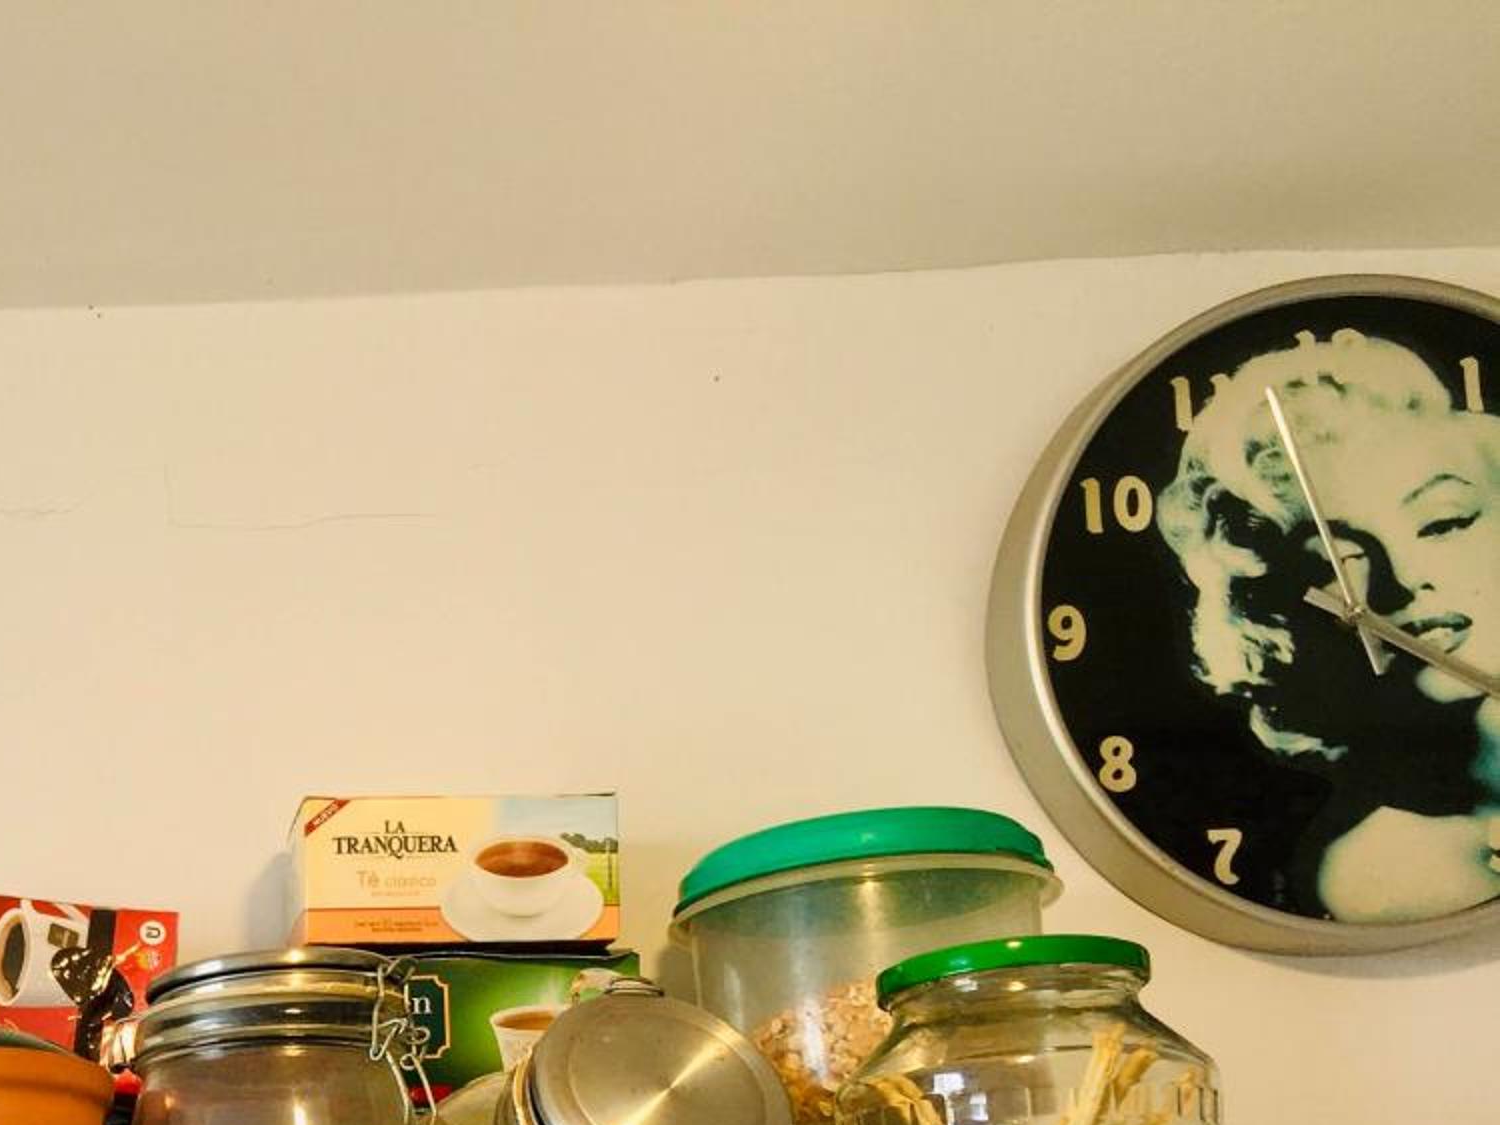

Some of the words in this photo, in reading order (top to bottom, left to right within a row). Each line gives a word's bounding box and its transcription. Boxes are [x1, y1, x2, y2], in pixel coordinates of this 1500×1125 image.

[1080, 475, 1153, 533] 10
[1047, 605, 1087, 662] 9
[1099, 735, 1137, 792] 8
[332, 835, 458, 859] TRANQUERA
[385, 820, 406, 834] LA
[1206, 828, 1243, 885] 7
